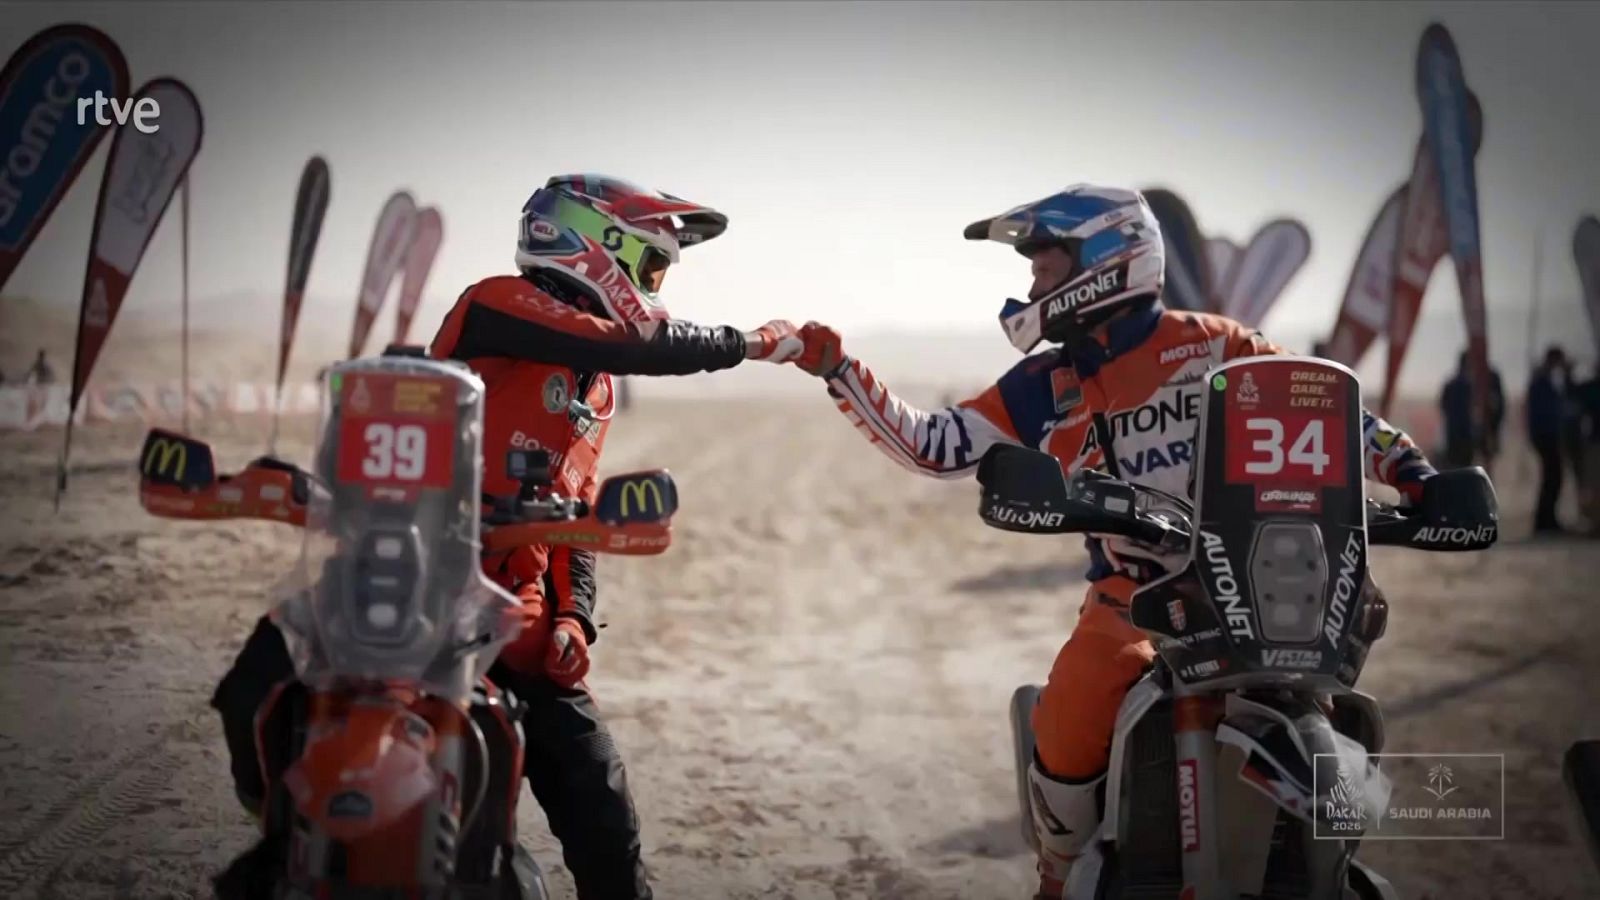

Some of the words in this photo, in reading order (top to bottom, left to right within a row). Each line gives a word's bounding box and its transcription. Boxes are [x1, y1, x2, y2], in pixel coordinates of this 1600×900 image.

[1047, 269, 1120, 319] AUTONET
[1160, 340, 1211, 364] MOTU
[1290, 371, 1339, 383] DREAM.
[1290, 396, 1318, 408] LIVE
[362, 422, 427, 480] 39
[1120, 437, 1196, 476] VAR
[1245, 417, 1330, 476] 34
[987, 505, 1065, 528] AUTONET
[1412, 524, 1495, 545] AUTONET
[1200, 530, 1255, 642] AUTONET
[1323, 531, 1363, 650] AUTONET
[1179, 765, 1197, 849] MOTUL
